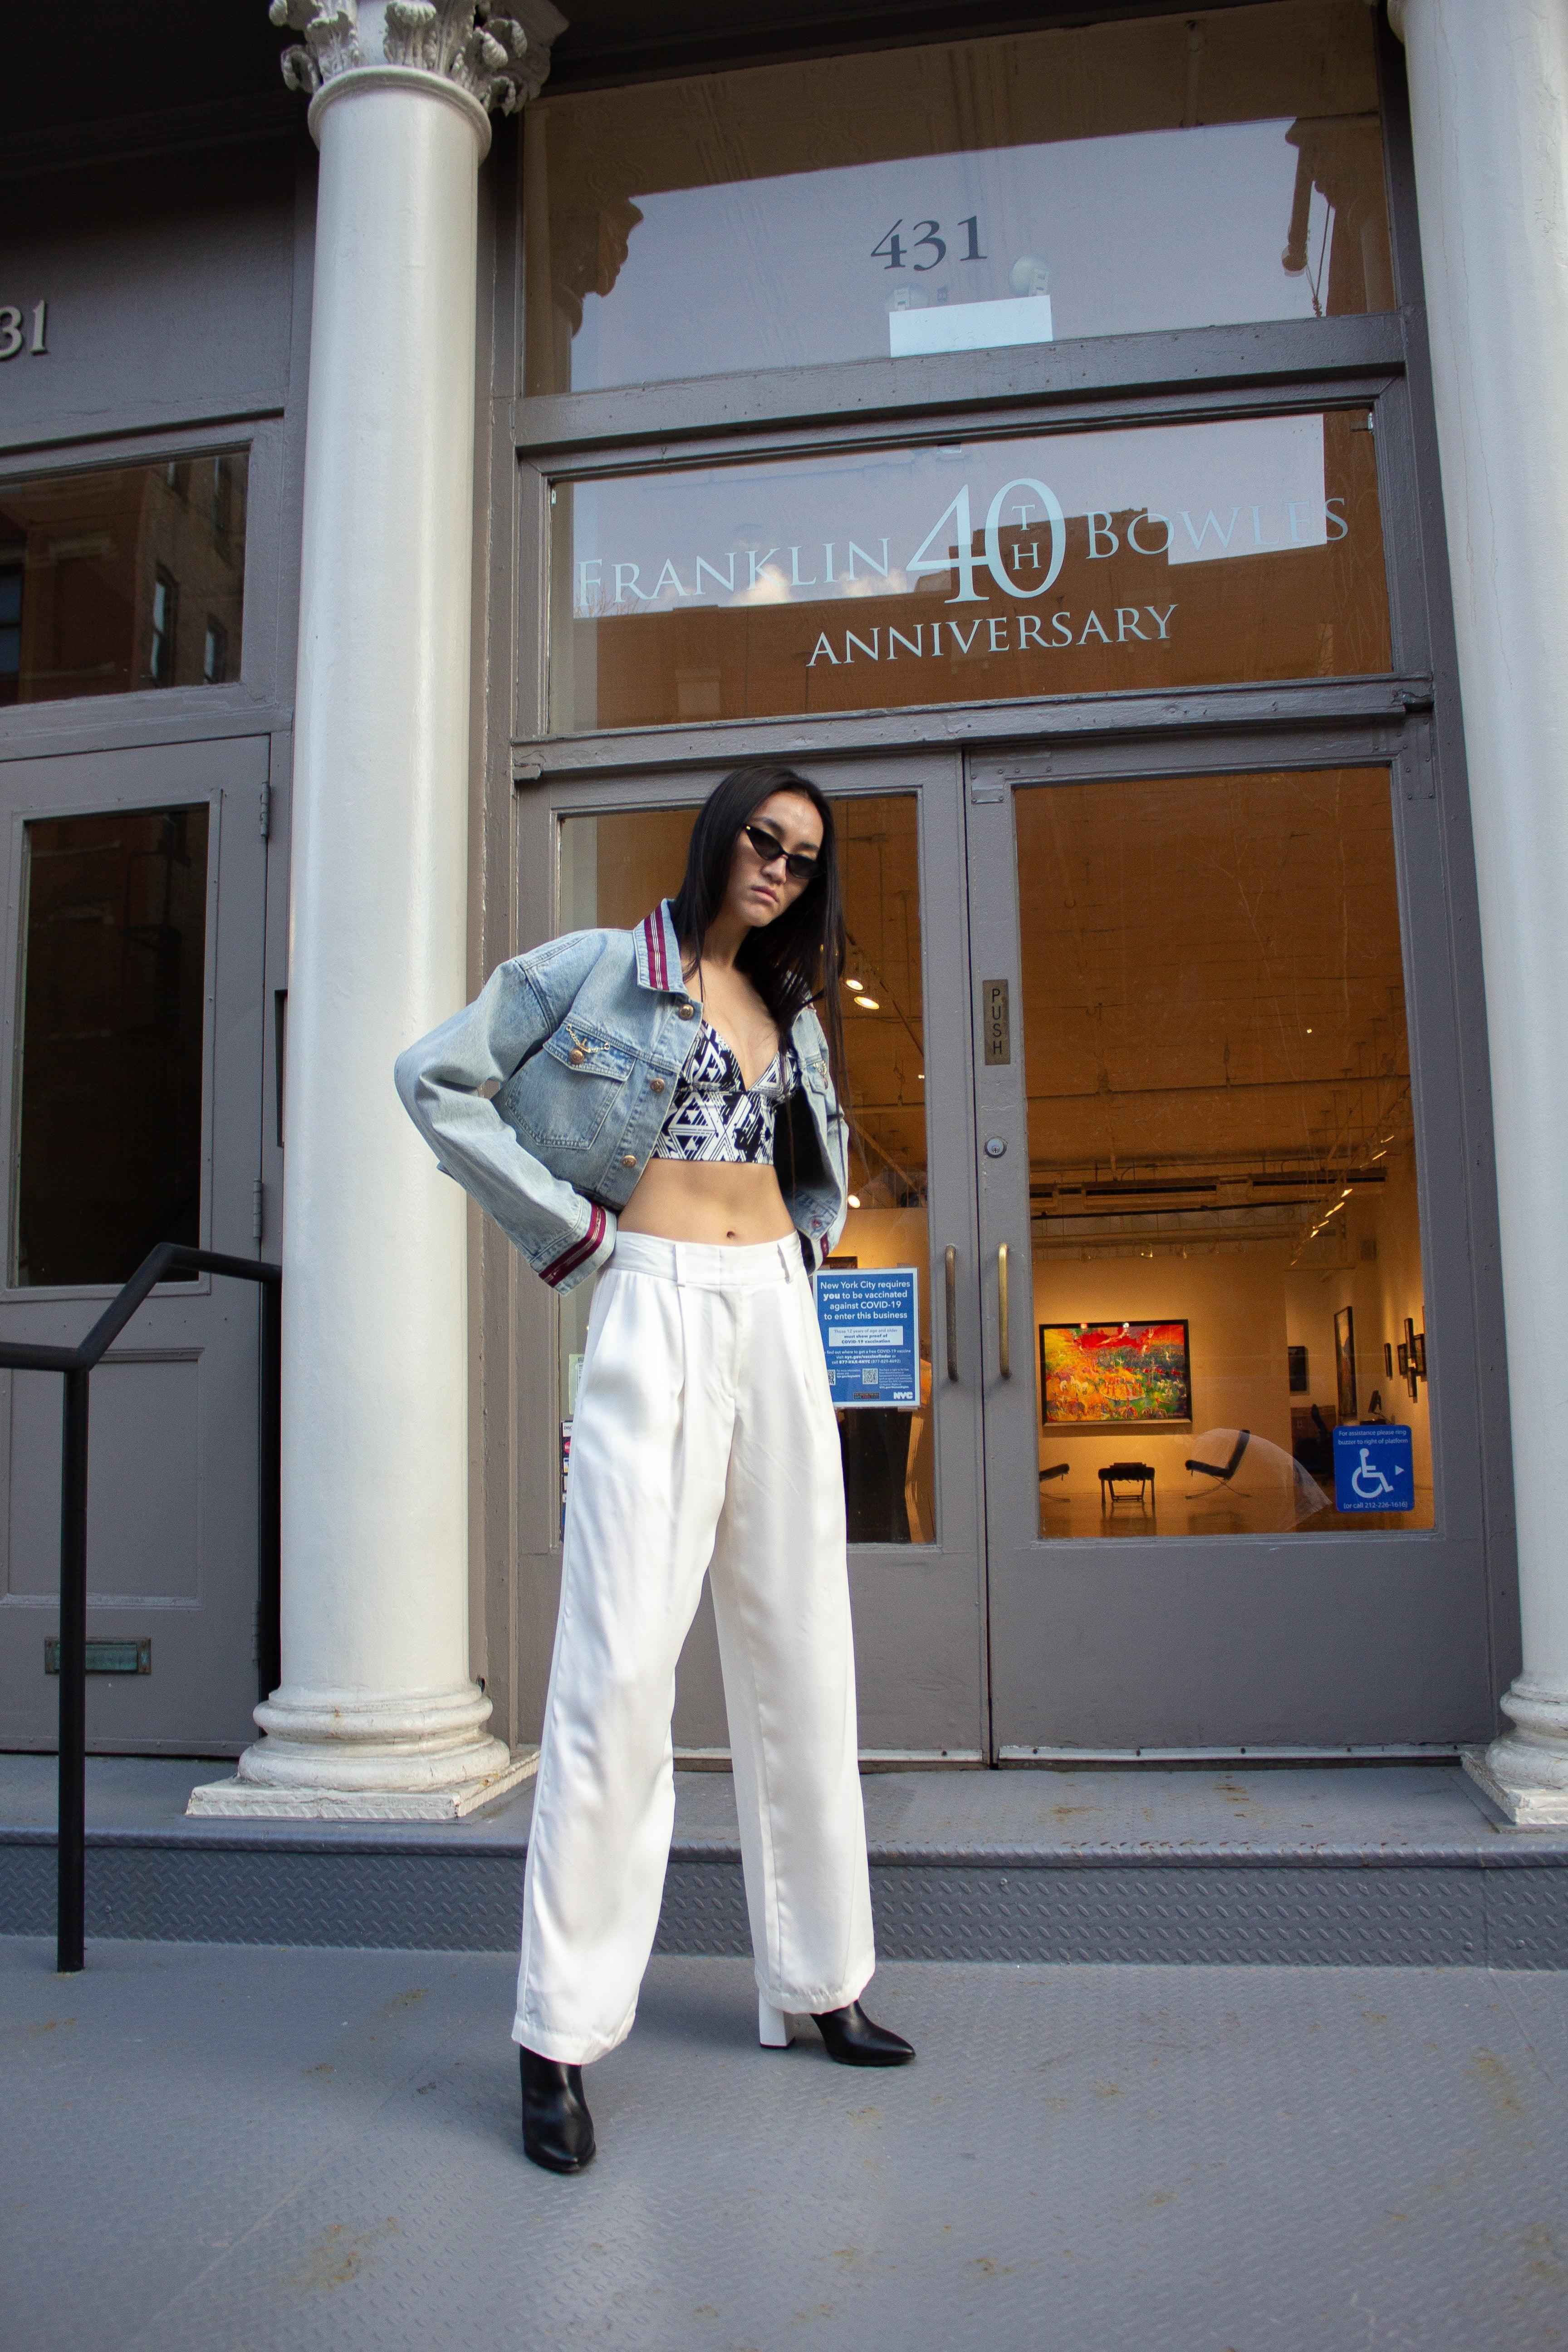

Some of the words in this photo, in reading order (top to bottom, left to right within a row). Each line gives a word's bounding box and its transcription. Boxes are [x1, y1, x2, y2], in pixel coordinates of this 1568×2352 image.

[871, 216, 988, 271] 431
[577, 538, 891, 606] FRANKLIN
[906, 478, 1066, 604] 40
[1085, 497, 1348, 559] BOWLES
[806, 604, 1178, 666] ANNIVERSARY
[991, 988, 1002, 1055] PUSH
[830, 1302, 858, 1311] against
[860, 1281, 876, 1290] City
[878, 1280, 910, 1289] requires
[865, 1290, 907, 1298] vaccinated
